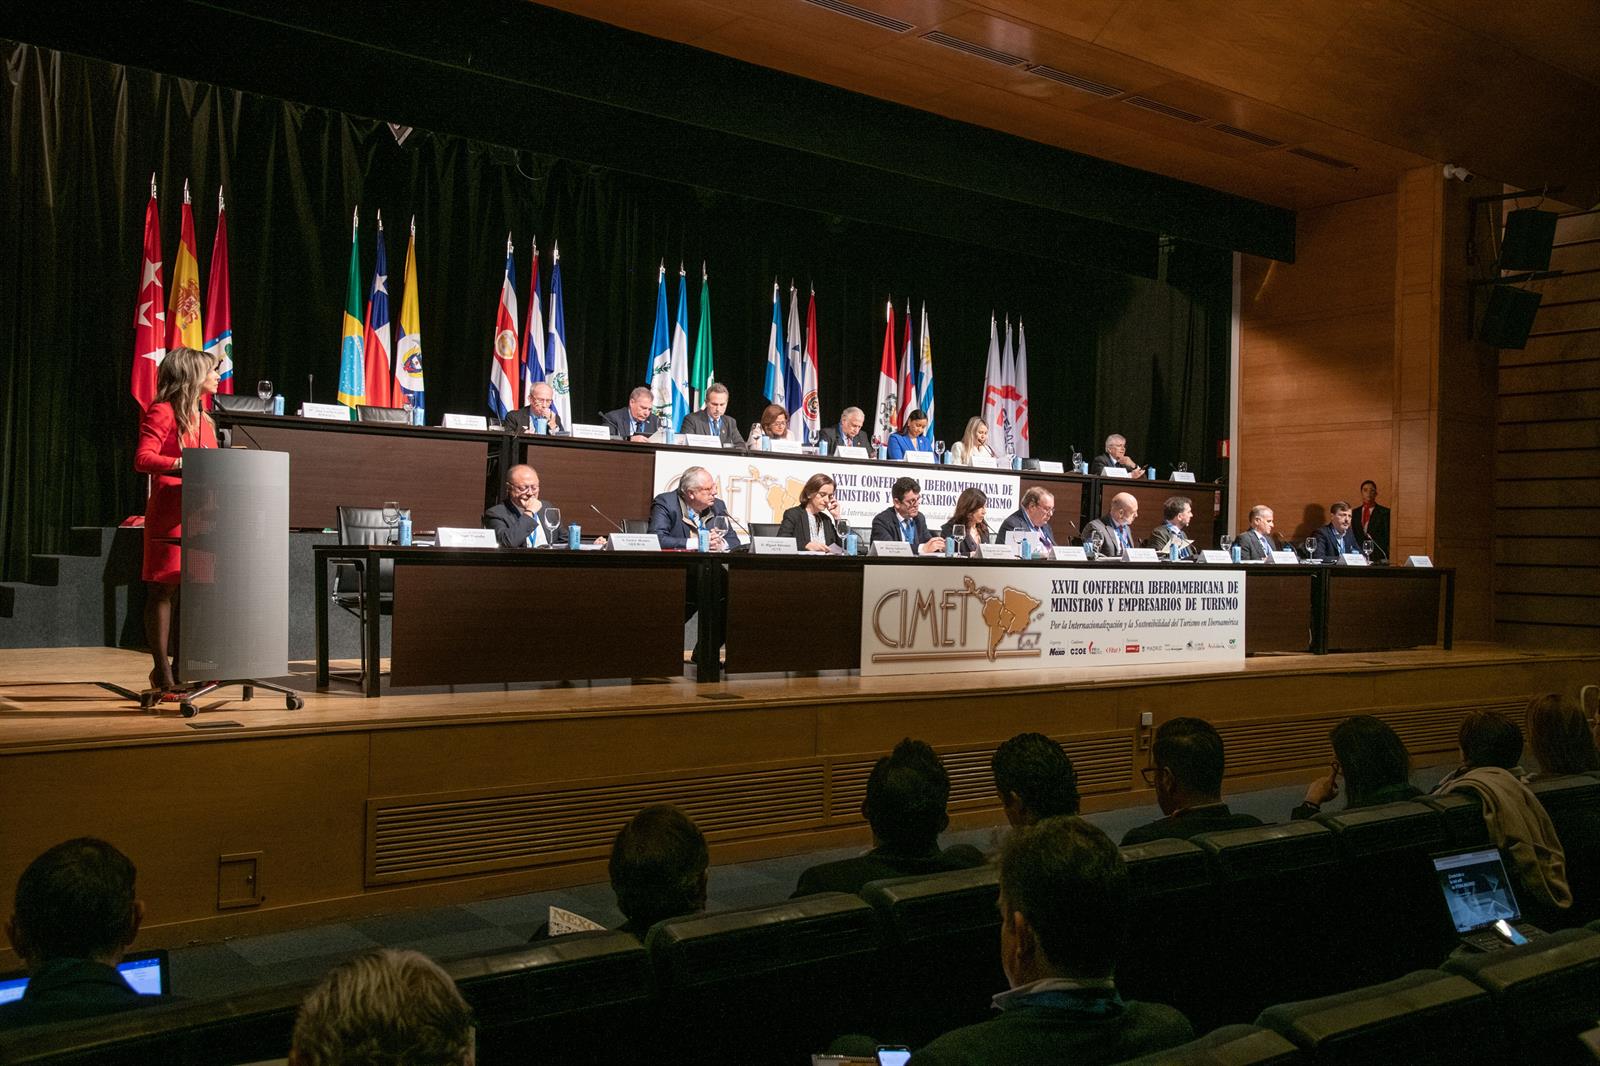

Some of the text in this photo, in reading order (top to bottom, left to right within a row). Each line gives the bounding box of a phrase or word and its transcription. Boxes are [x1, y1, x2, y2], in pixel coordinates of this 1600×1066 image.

[1002, 484, 1013, 496] DE
[886, 491, 892, 504] Y
[986, 497, 1012, 510] RISMO
[1051, 580, 1238, 594] XXVII CONFERENCIA IBEROAMERICANA DE
[1050, 597, 1238, 612] MINISTROS Y EMPRESARIOS DE TURISMO
[872, 589, 973, 648] CIMET
[1050, 619, 1061, 630] Por
[1061, 619, 1068, 629] la
[1068, 619, 1123, 632] Internacionalización
[1122, 622, 1127, 632] y
[1128, 619, 1134, 629] la
[1134, 618, 1170, 629] Sostenibilidad
[1170, 618, 1179, 628] del
[1179, 618, 1200, 628] Turismo
